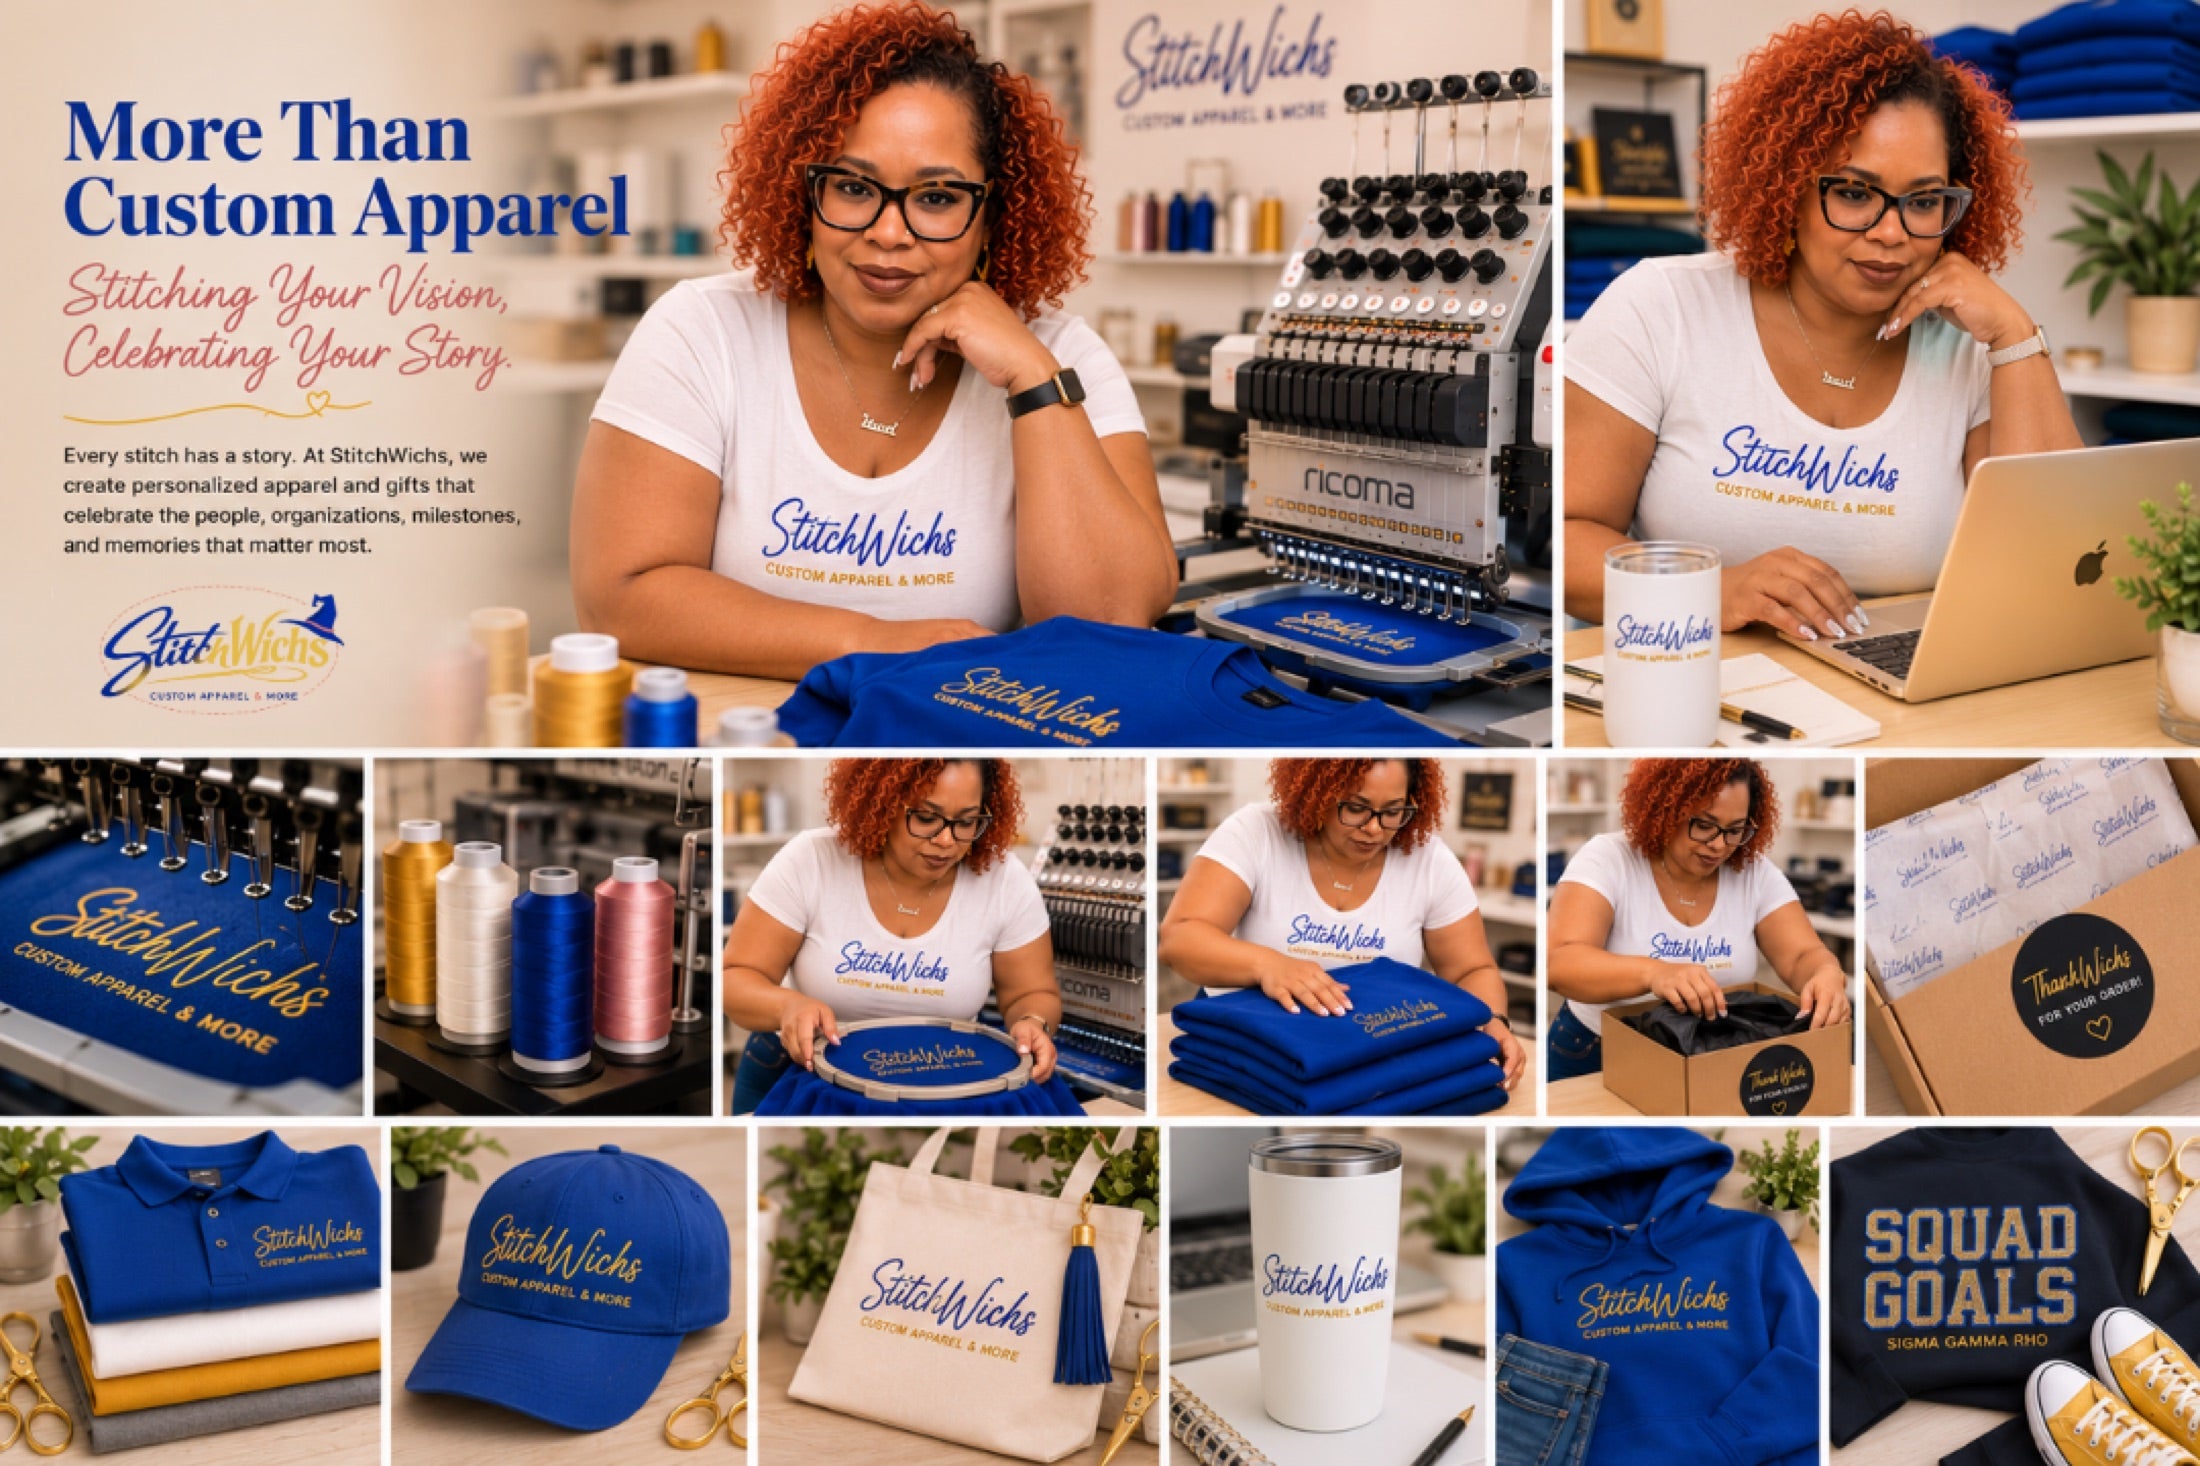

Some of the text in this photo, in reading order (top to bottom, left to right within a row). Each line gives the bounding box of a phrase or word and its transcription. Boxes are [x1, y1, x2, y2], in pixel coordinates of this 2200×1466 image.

[1115, 4, 1338, 109] StitchWichs
[1191, 107, 1259, 125] APPAREL
[1281, 102, 1328, 119] MORE
[1713, 425, 1899, 493] StitchWichs
[1304, 463, 1415, 510] ricoma
[1715, 481, 1896, 516] CUSTOM APPAREL & MORE
[762, 497, 957, 567] StitchWichs
[765, 562, 956, 587] CUSTOM APPAREL & MORE
[941, 667, 1120, 737] StitchWichs
[30, 887, 330, 1018] StitchWichs
[2022, 944, 2132, 1006] ThankWichs
[13, 942, 279, 1055] CUSTOM APPAREL & MORE
[2038, 1009, 2063, 1027] FOR
[2064, 995, 2097, 1015] YOUR
[253, 1219, 363, 1258] StitchWichs
[481, 1213, 642, 1284] StitchWichs
[1865, 1204, 2079, 1265] SQUAD
[481, 1272, 632, 1308] CUSTOM APPAREL & MORE
[860, 1258, 1036, 1336] StitchWichs
[1263, 1253, 1388, 1304] StitchWichs
[1577, 1276, 1729, 1328] StitchWichs
[1863, 1266, 2078, 1330] GOALS
[860, 1315, 1020, 1363] CUSTOM APPAREL & MORE
[1582, 1325, 1631, 1340] CUSTOM
[1634, 1321, 1682, 1334] APPAREL
[1696, 1320, 1729, 1330] MORE
[1887, 1333, 2049, 1350] SIGMA GAMMA RHO
